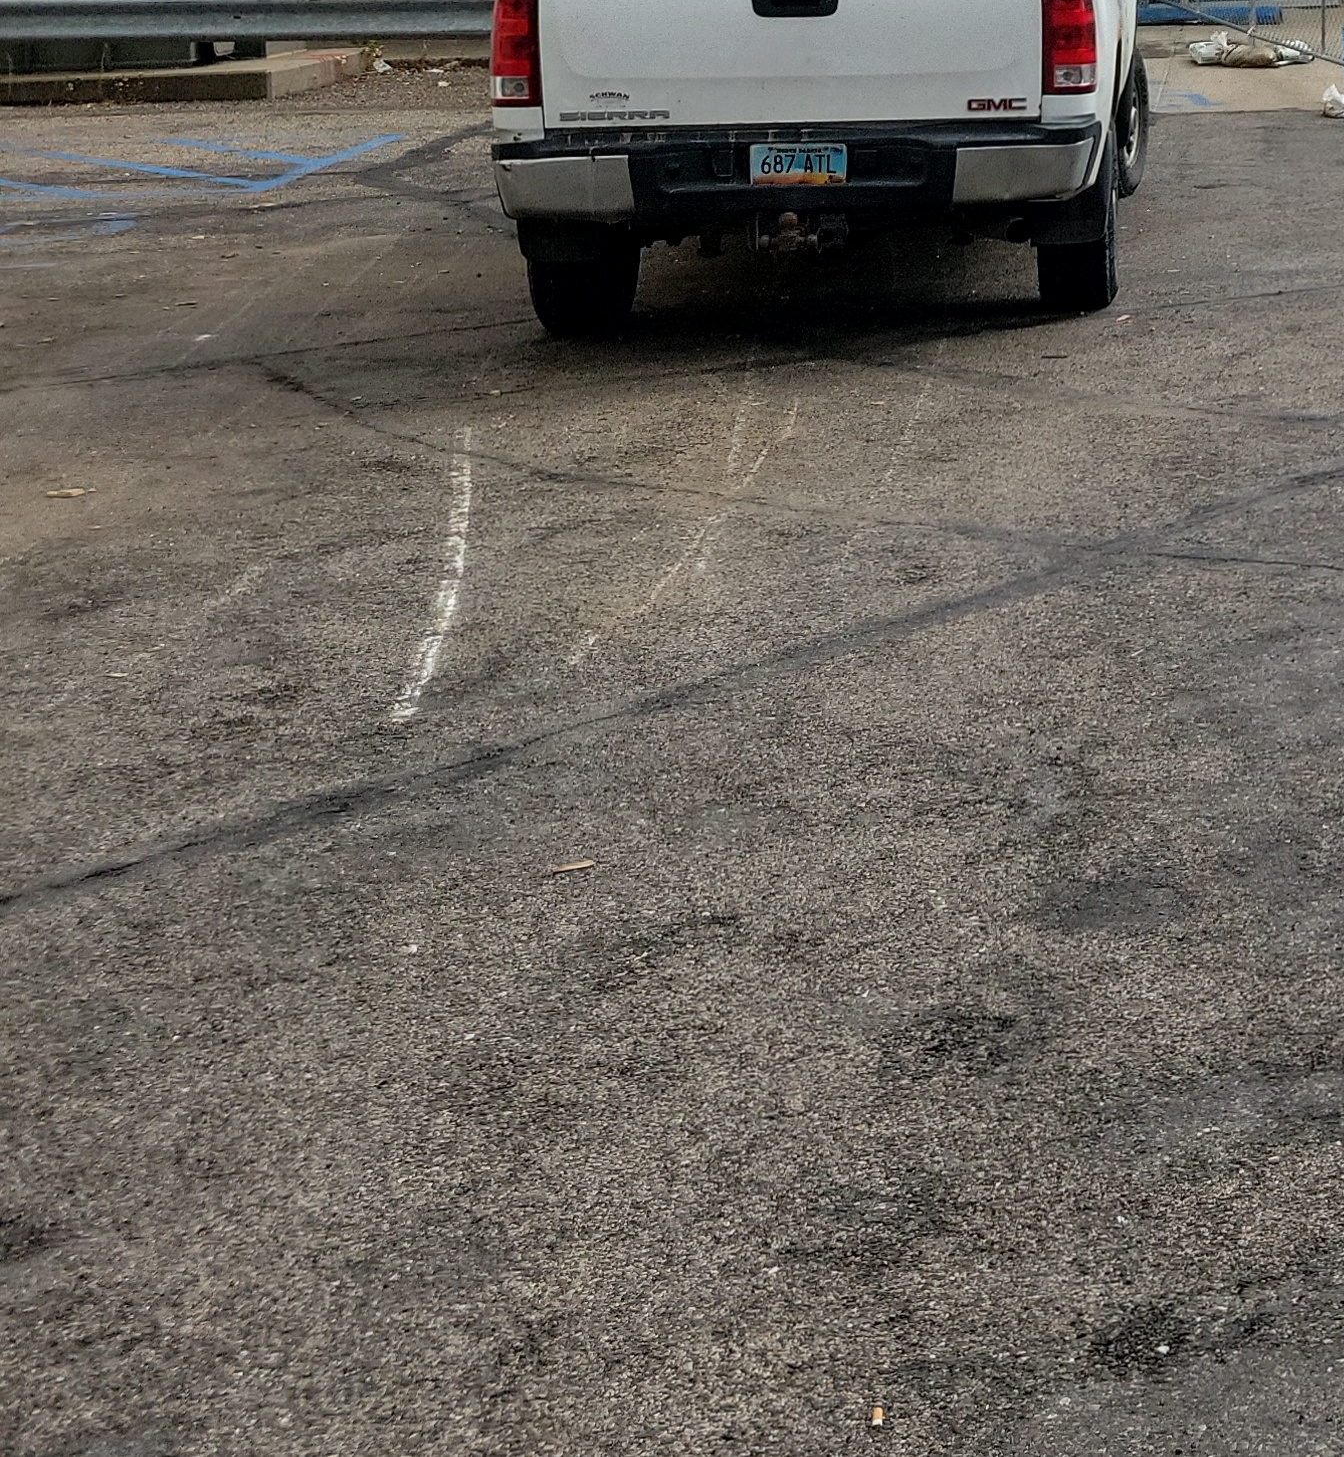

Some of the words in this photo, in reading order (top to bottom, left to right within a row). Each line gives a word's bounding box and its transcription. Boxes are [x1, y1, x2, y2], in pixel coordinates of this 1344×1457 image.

[589, 91, 630, 102] SCHWAN
[967, 97, 1027, 111] GMC
[559, 109, 670, 122] SIERRA
[760, 154, 796, 175] 687
[804, 154, 837, 174] ATL
